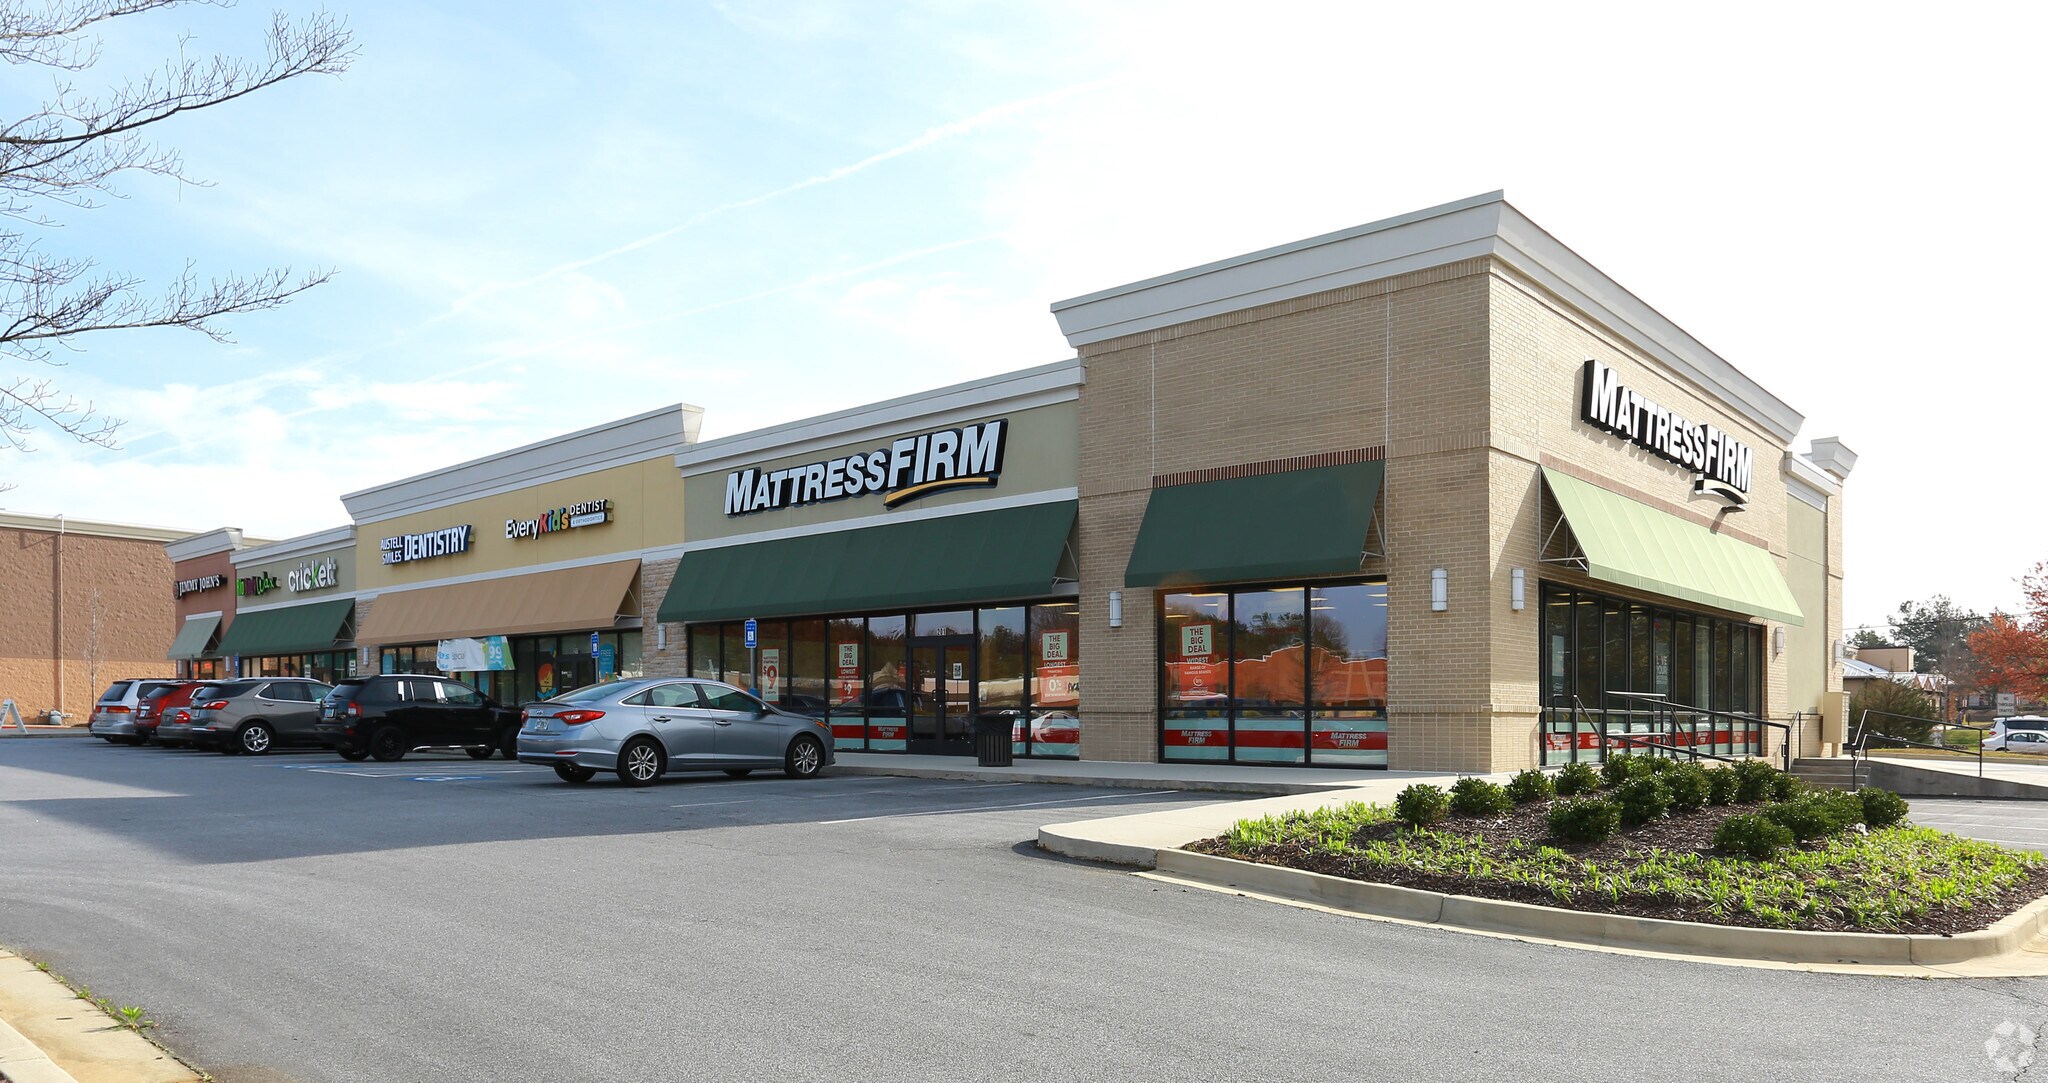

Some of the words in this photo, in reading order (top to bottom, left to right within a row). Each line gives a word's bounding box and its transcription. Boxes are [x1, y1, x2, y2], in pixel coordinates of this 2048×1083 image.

[569, 499, 605, 516] DENTIST
[380, 536, 403, 550] AUSTELL
[404, 525, 469, 562] DENTISTRY
[382, 550, 402, 565] SMILES
[288, 557, 336, 592] cricket
[179, 578, 199, 597] JIMMY
[199, 574, 220, 593] JOHN'S
[1190, 628, 1203, 636] THE
[1190, 636, 1204, 645] BIG
[1049, 642, 1060, 650] BIG
[1187, 645, 1207, 653] DEAL
[1181, 729, 1212, 738] MATTRESS
[1330, 732, 1367, 740] MATTRESS
[1338, 739, 1360, 747] FIRM
